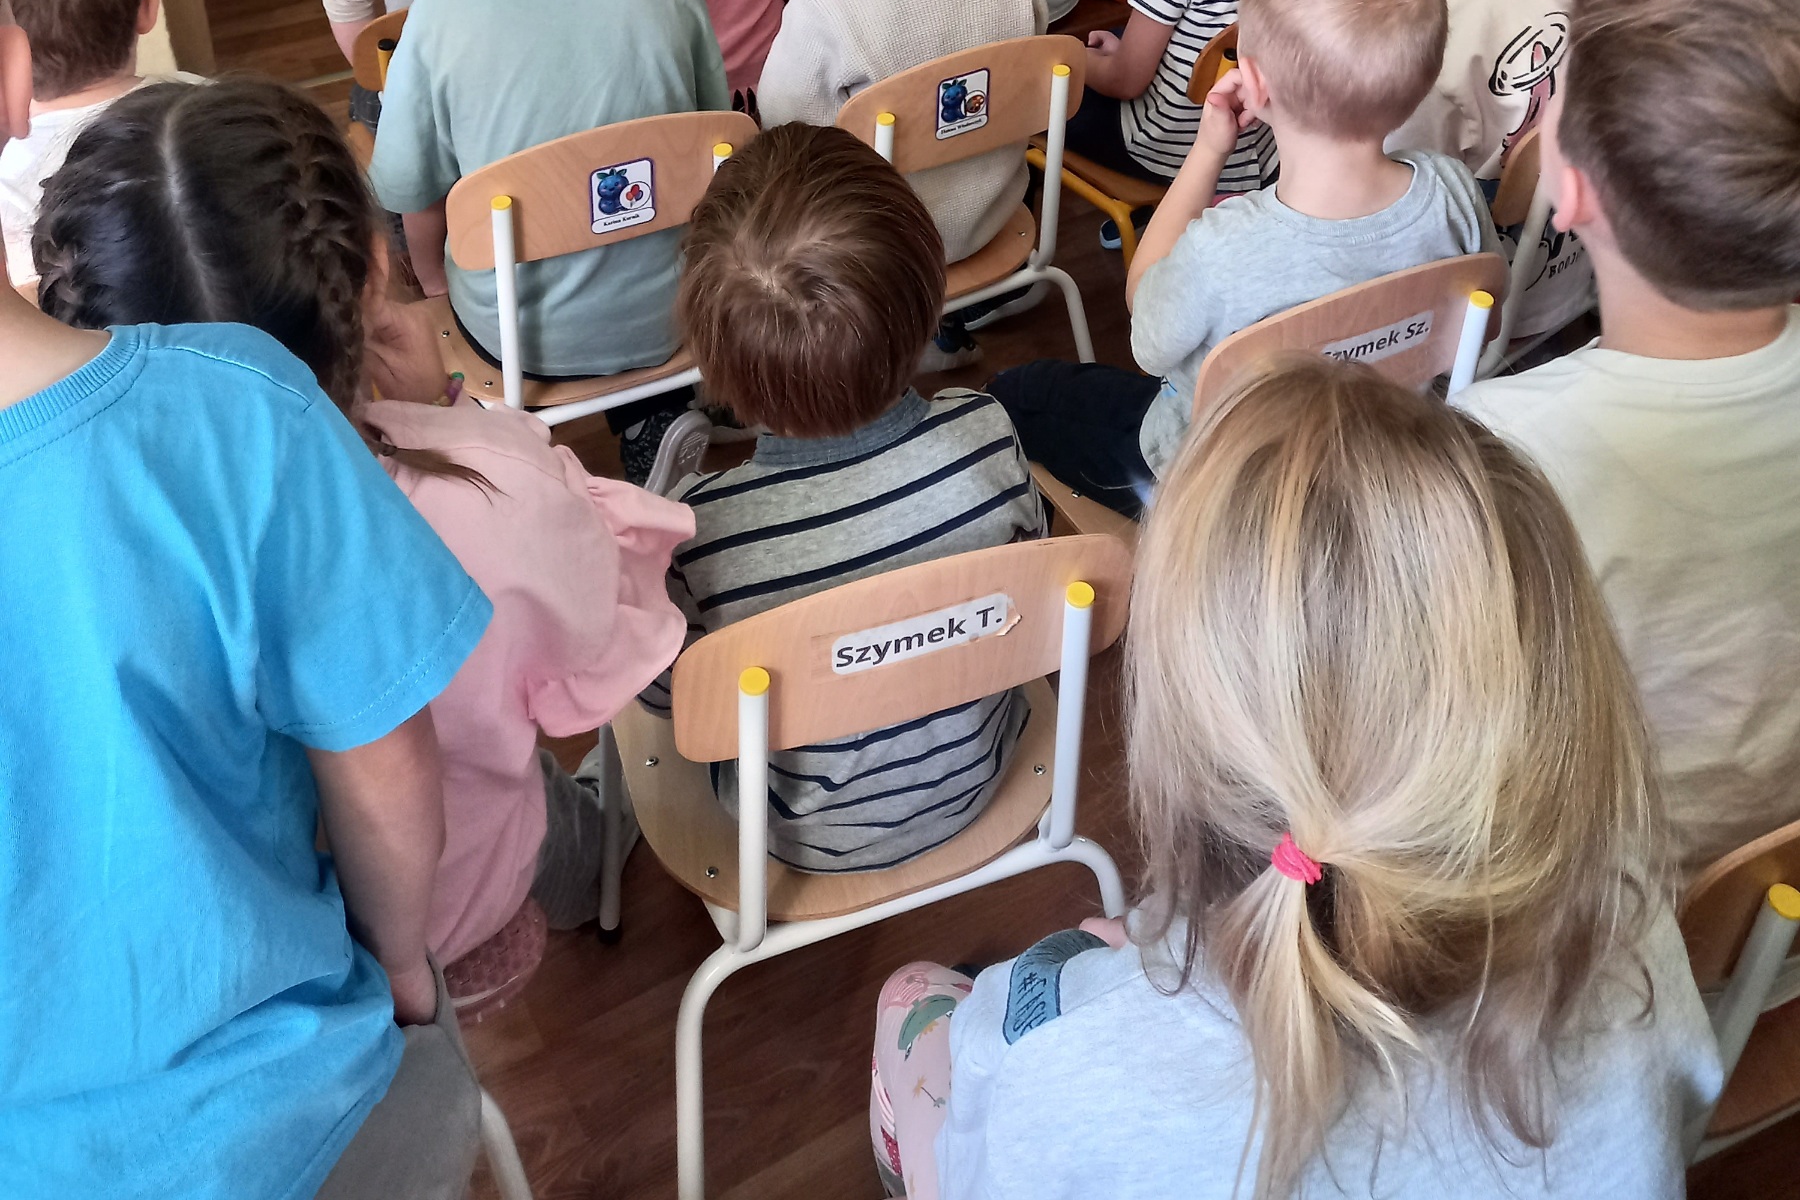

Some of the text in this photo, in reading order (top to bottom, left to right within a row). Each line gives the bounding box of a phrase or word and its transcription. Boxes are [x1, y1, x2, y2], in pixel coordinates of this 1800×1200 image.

[1404, 321, 1429, 340] Sz.
[836, 606, 1003, 668] Szymek T.
